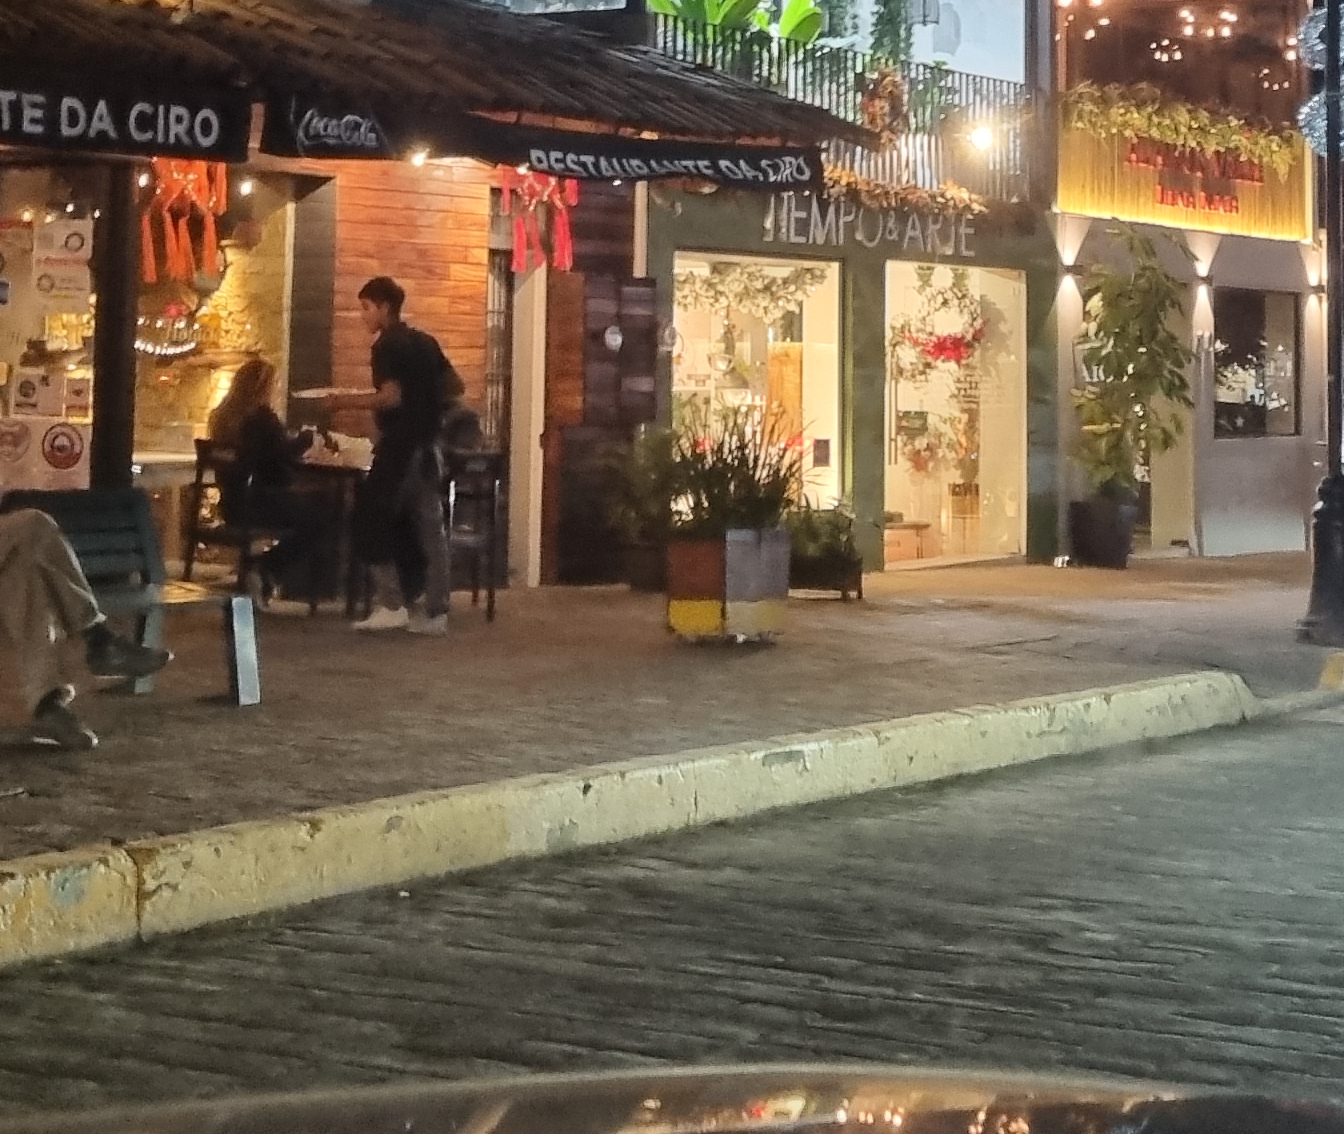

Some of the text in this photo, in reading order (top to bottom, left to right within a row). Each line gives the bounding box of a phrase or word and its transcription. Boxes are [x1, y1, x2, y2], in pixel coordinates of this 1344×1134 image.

[60, 95, 117, 139] DA
[128, 101, 220, 148] CIRO
[718, 158, 764, 182] DA
[760, 155, 811, 183] CIRO
